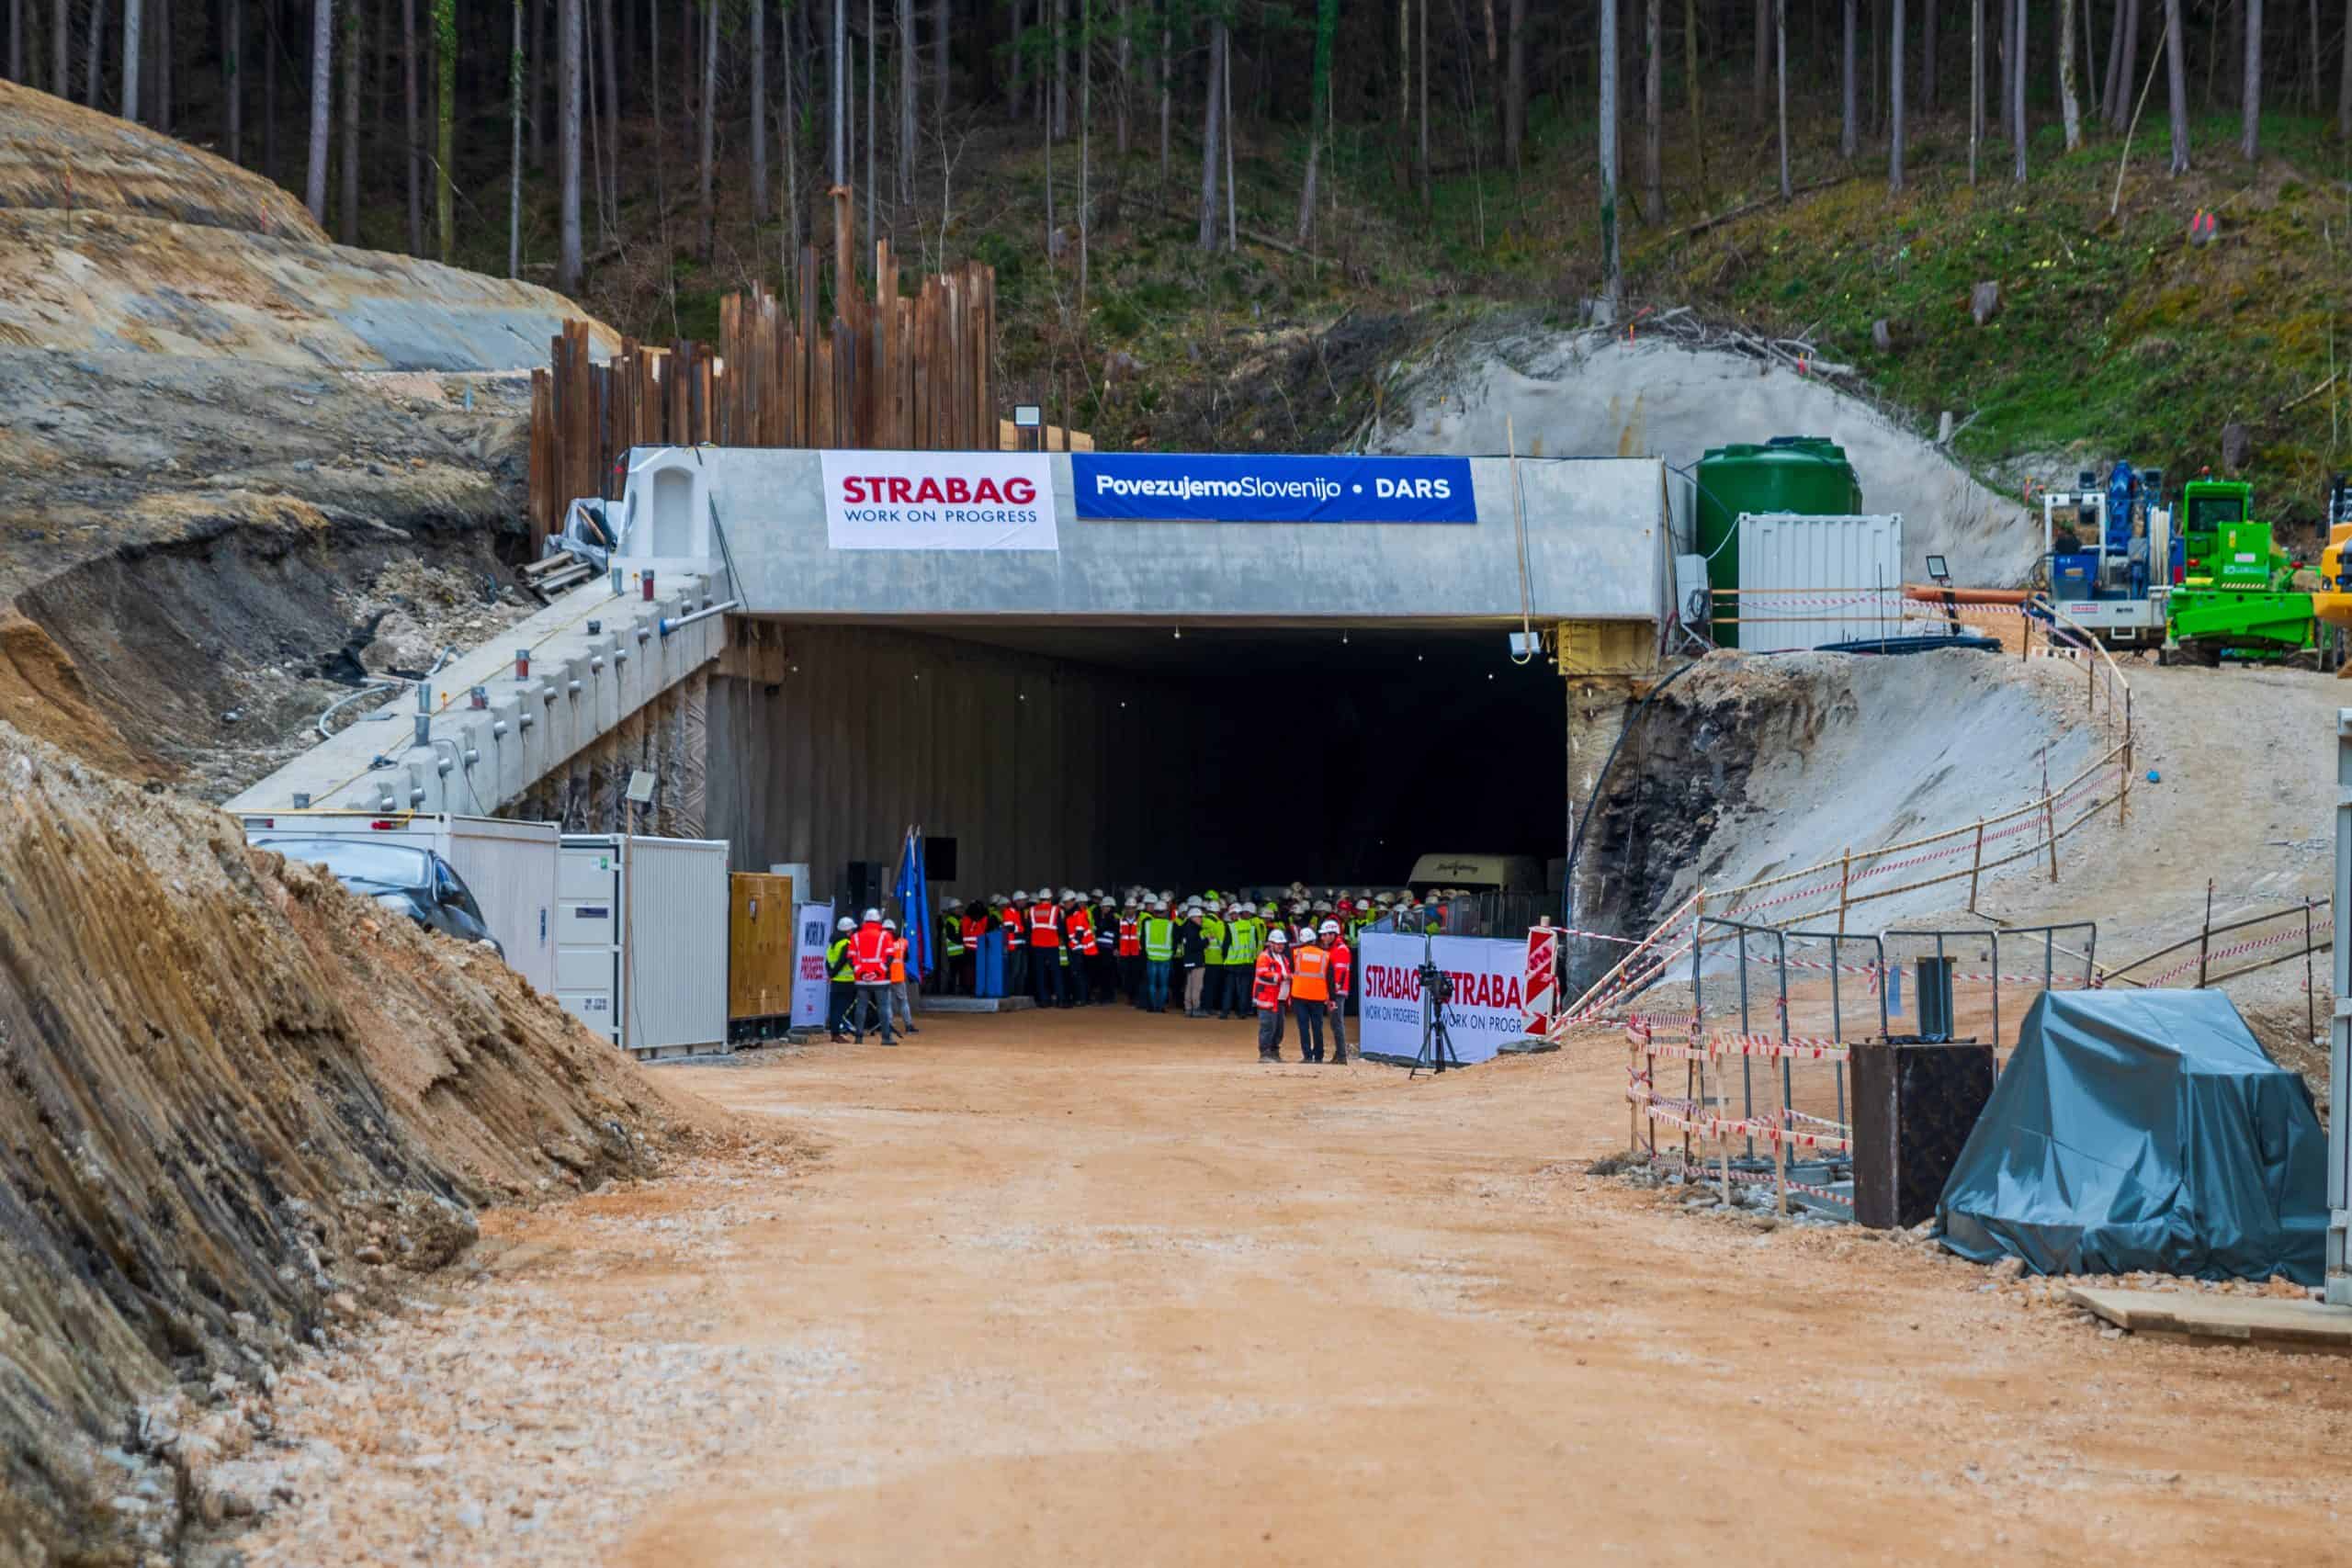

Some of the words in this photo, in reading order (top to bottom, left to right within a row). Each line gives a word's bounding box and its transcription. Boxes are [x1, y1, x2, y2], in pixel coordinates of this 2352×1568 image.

[842, 476, 1036, 504] STRABAG
[1096, 475, 1341, 502] PovezujemoSlovenijo
[1375, 479, 1451, 499] DARS
[844, 509, 900, 522] WORK
[907, 509, 936, 523] ON
[945, 510, 1036, 523] PROGRESS
[1365, 964, 1421, 1003] STRABAG
[1441, 970, 1525, 1010] TRABA
[1470, 1014, 1486, 1030] ON
